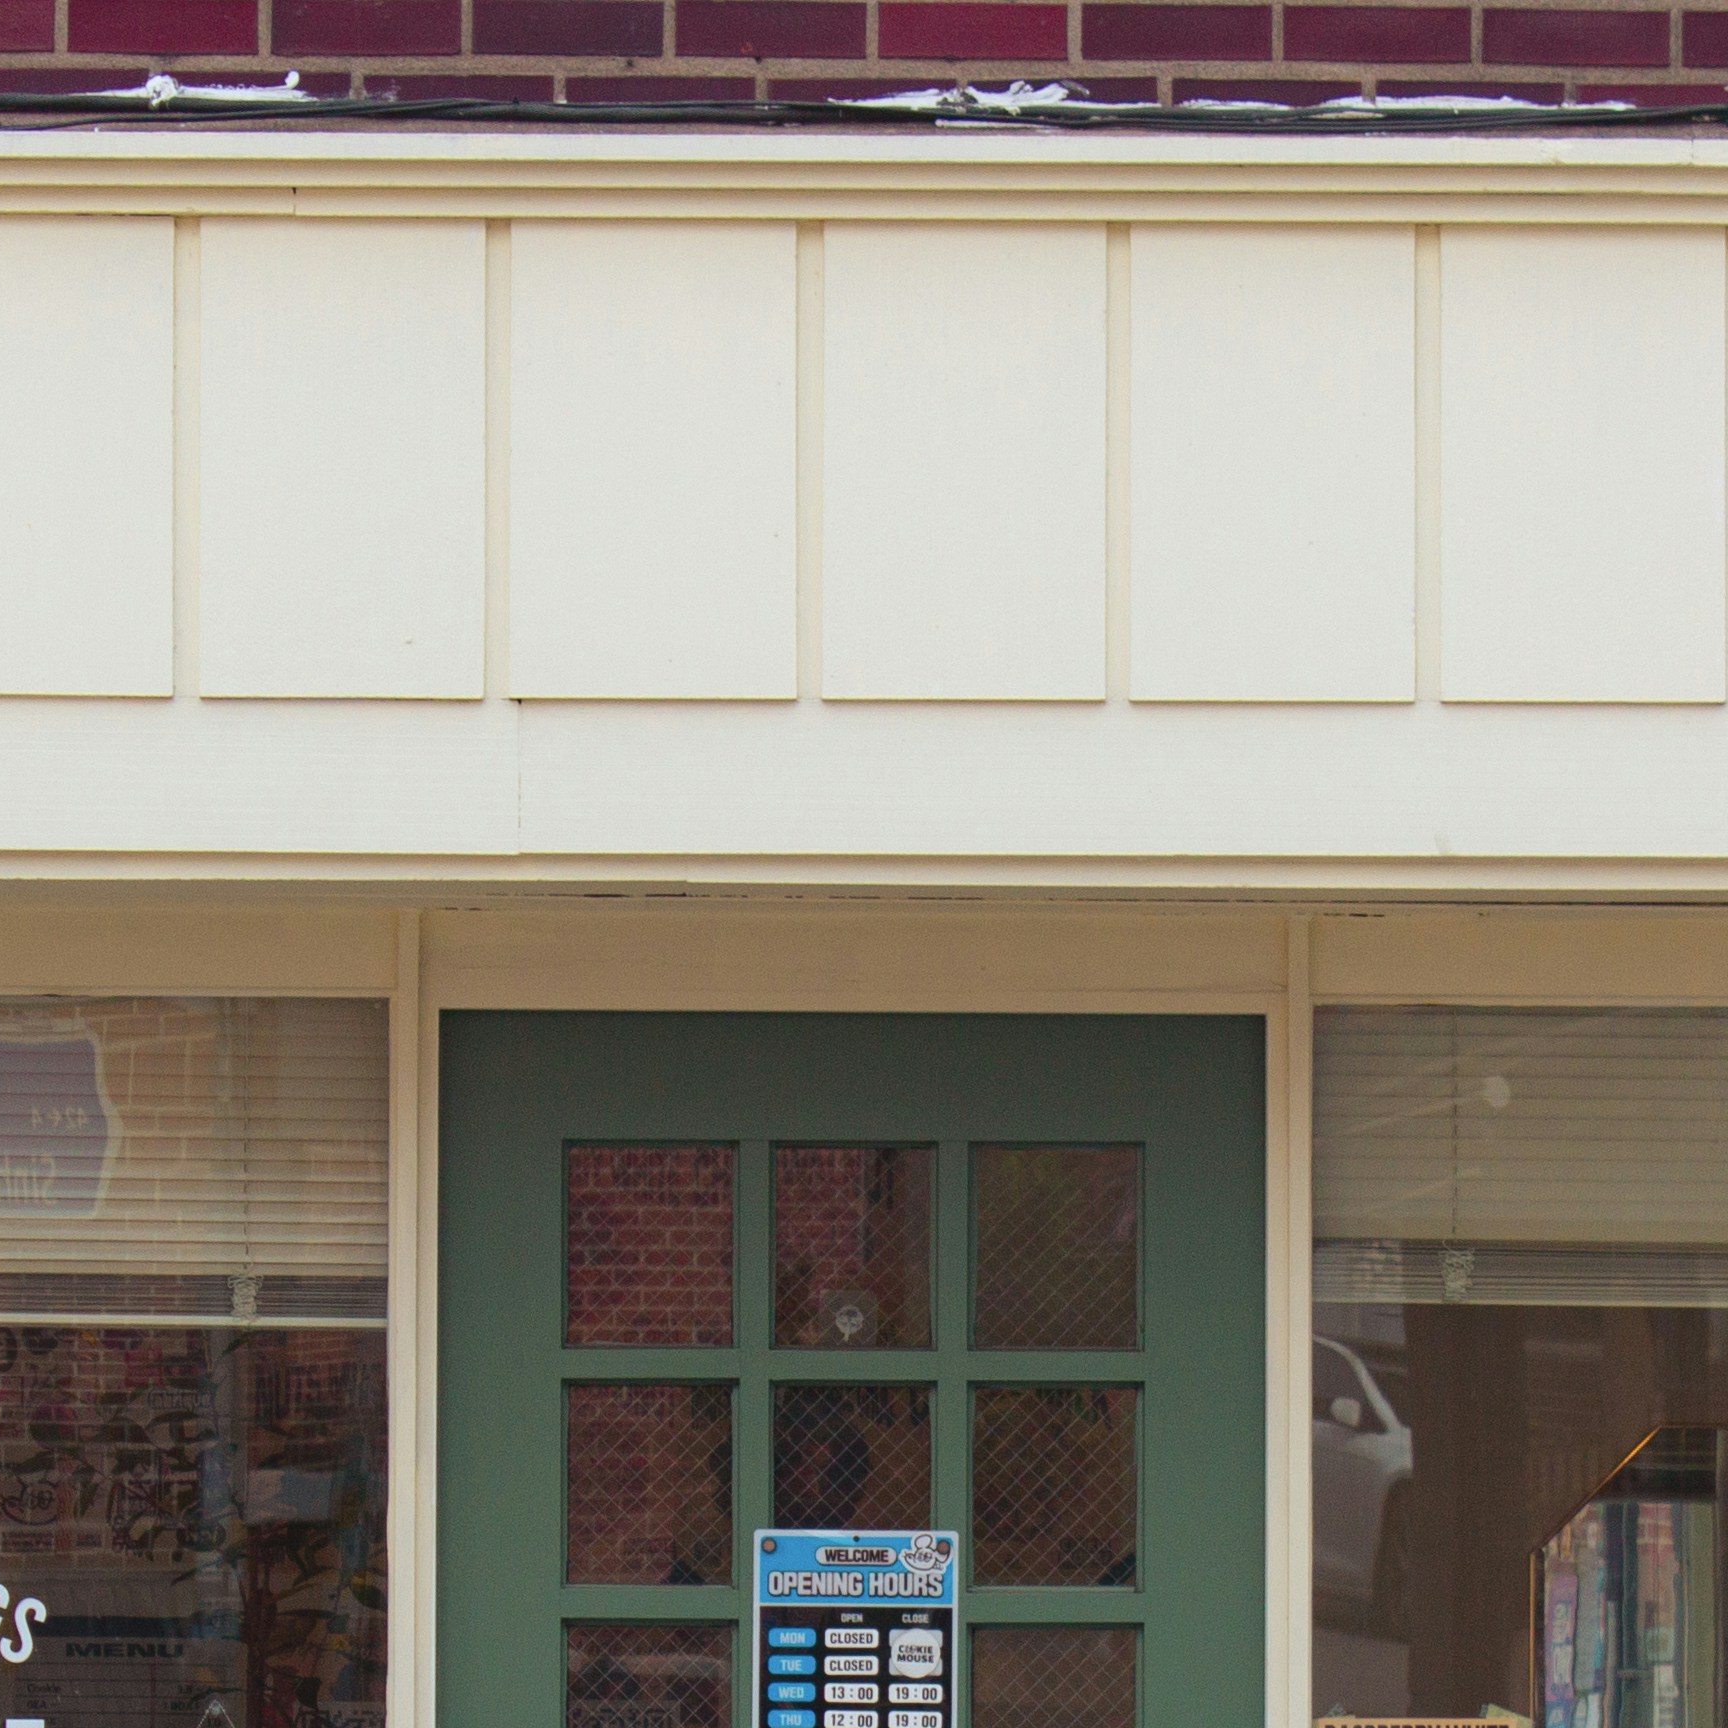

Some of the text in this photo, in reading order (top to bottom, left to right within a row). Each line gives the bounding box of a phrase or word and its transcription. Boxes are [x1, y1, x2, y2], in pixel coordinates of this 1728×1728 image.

[824, 1549, 889, 1563] WELCOME
[768, 1571, 944, 1597] OPENING HOURS
[841, 1613, 929, 1623] OPEN CLOSE
[779, 1632, 873, 1645] MON CLOSED
[66, 1643, 184, 1657] MENU
[898, 1644, 933, 1655] COOKIE
[897, 1654, 934, 1664] MOUSE
[780, 1660, 873, 1672] TUE CLOSED
[778, 1687, 804, 1699] WED
[779, 1714, 802, 1726] THU
